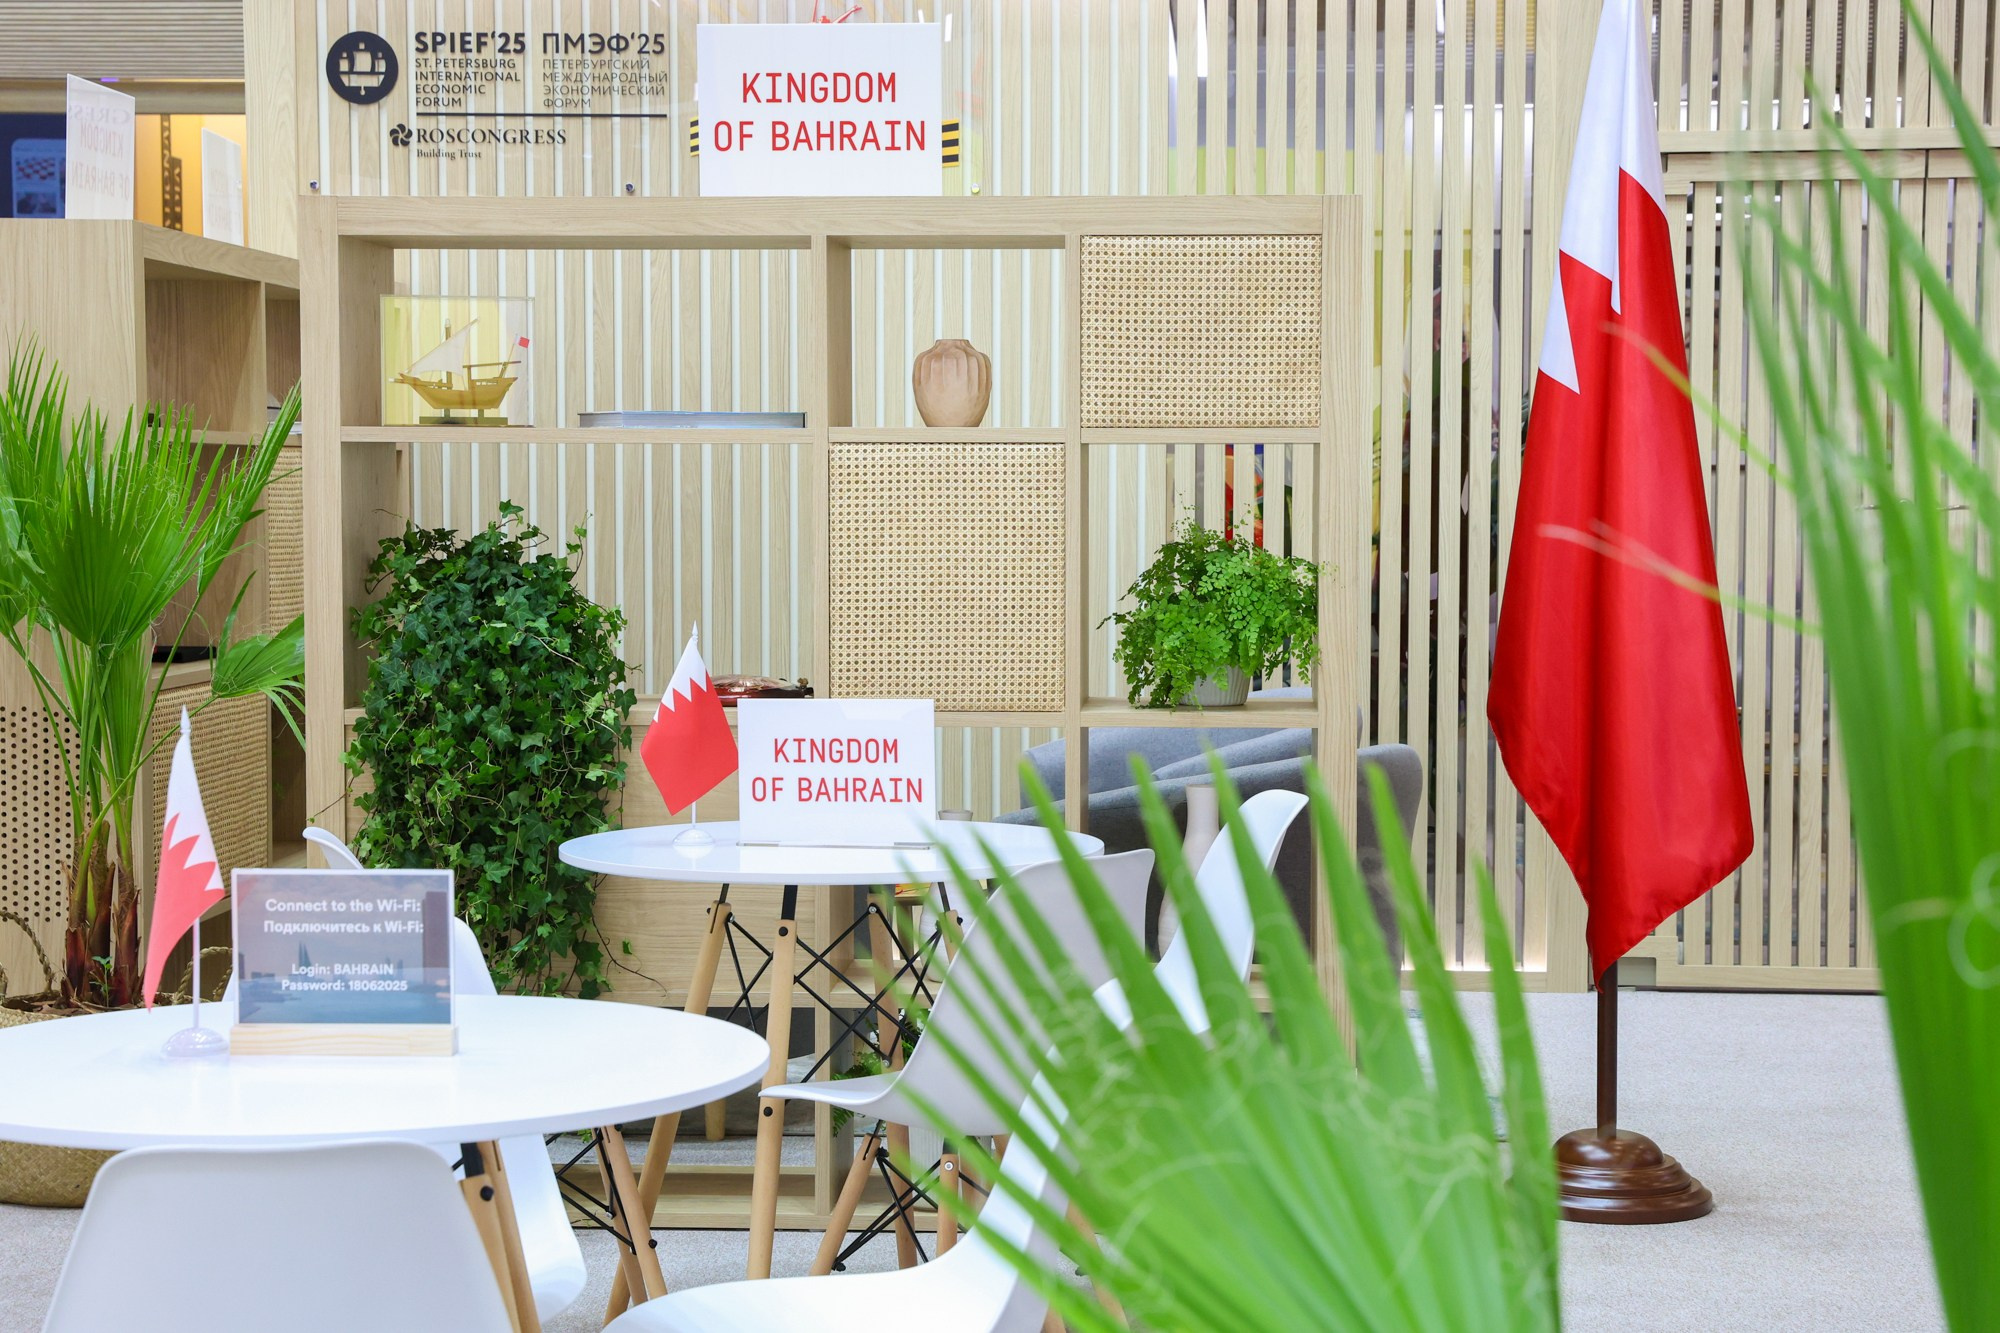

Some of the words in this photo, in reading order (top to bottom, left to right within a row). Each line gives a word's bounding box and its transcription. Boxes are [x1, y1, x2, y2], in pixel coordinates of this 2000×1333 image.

[415, 31, 526, 55] SPIEF'25
[415, 58, 432, 69] ST.
[435, 58, 516, 69] PETERSBURG
[542, 58, 650, 70] ПЕТЕРБУРГСКИЙ
[415, 71, 521, 82] INTERNATIONAL
[542, 71, 667, 83] МЕЖДУНАРОДНЫЙ
[415, 84, 486, 95] ECONOMIC
[543, 84, 665, 96] ЭКОНОМИЧЕСКИЙ
[742, 72, 896, 103] KINGDOM
[415, 97, 462, 107] FORUM
[543, 97, 591, 109] ФОРУМ
[416, 128, 567, 145] ROSCONGRESS
[714, 121, 754, 151] OF
[771, 121, 925, 151] BAHRAIN
[416, 149, 455, 160] Building
[458, 150, 482, 159] Trust
[774, 738, 898, 763] KINGDOM
[752, 777, 784, 802] OF
[798, 777, 923, 803] BAHRAIN
[265, 899, 327, 912] Connect
[331, 900, 347, 912] to
[350, 899, 373, 912] the
[377, 899, 422, 912] Wi-Fi:
[264, 920, 370, 935] Подключитесь
[373, 923, 382, 932] к
[384, 920, 424, 933] Wi-Fi:
[292, 964, 331, 978] Login:
[334, 964, 393, 975] BAHRAIN
[281, 980, 345, 991] Password:
[348, 981, 408, 991] 18062025
